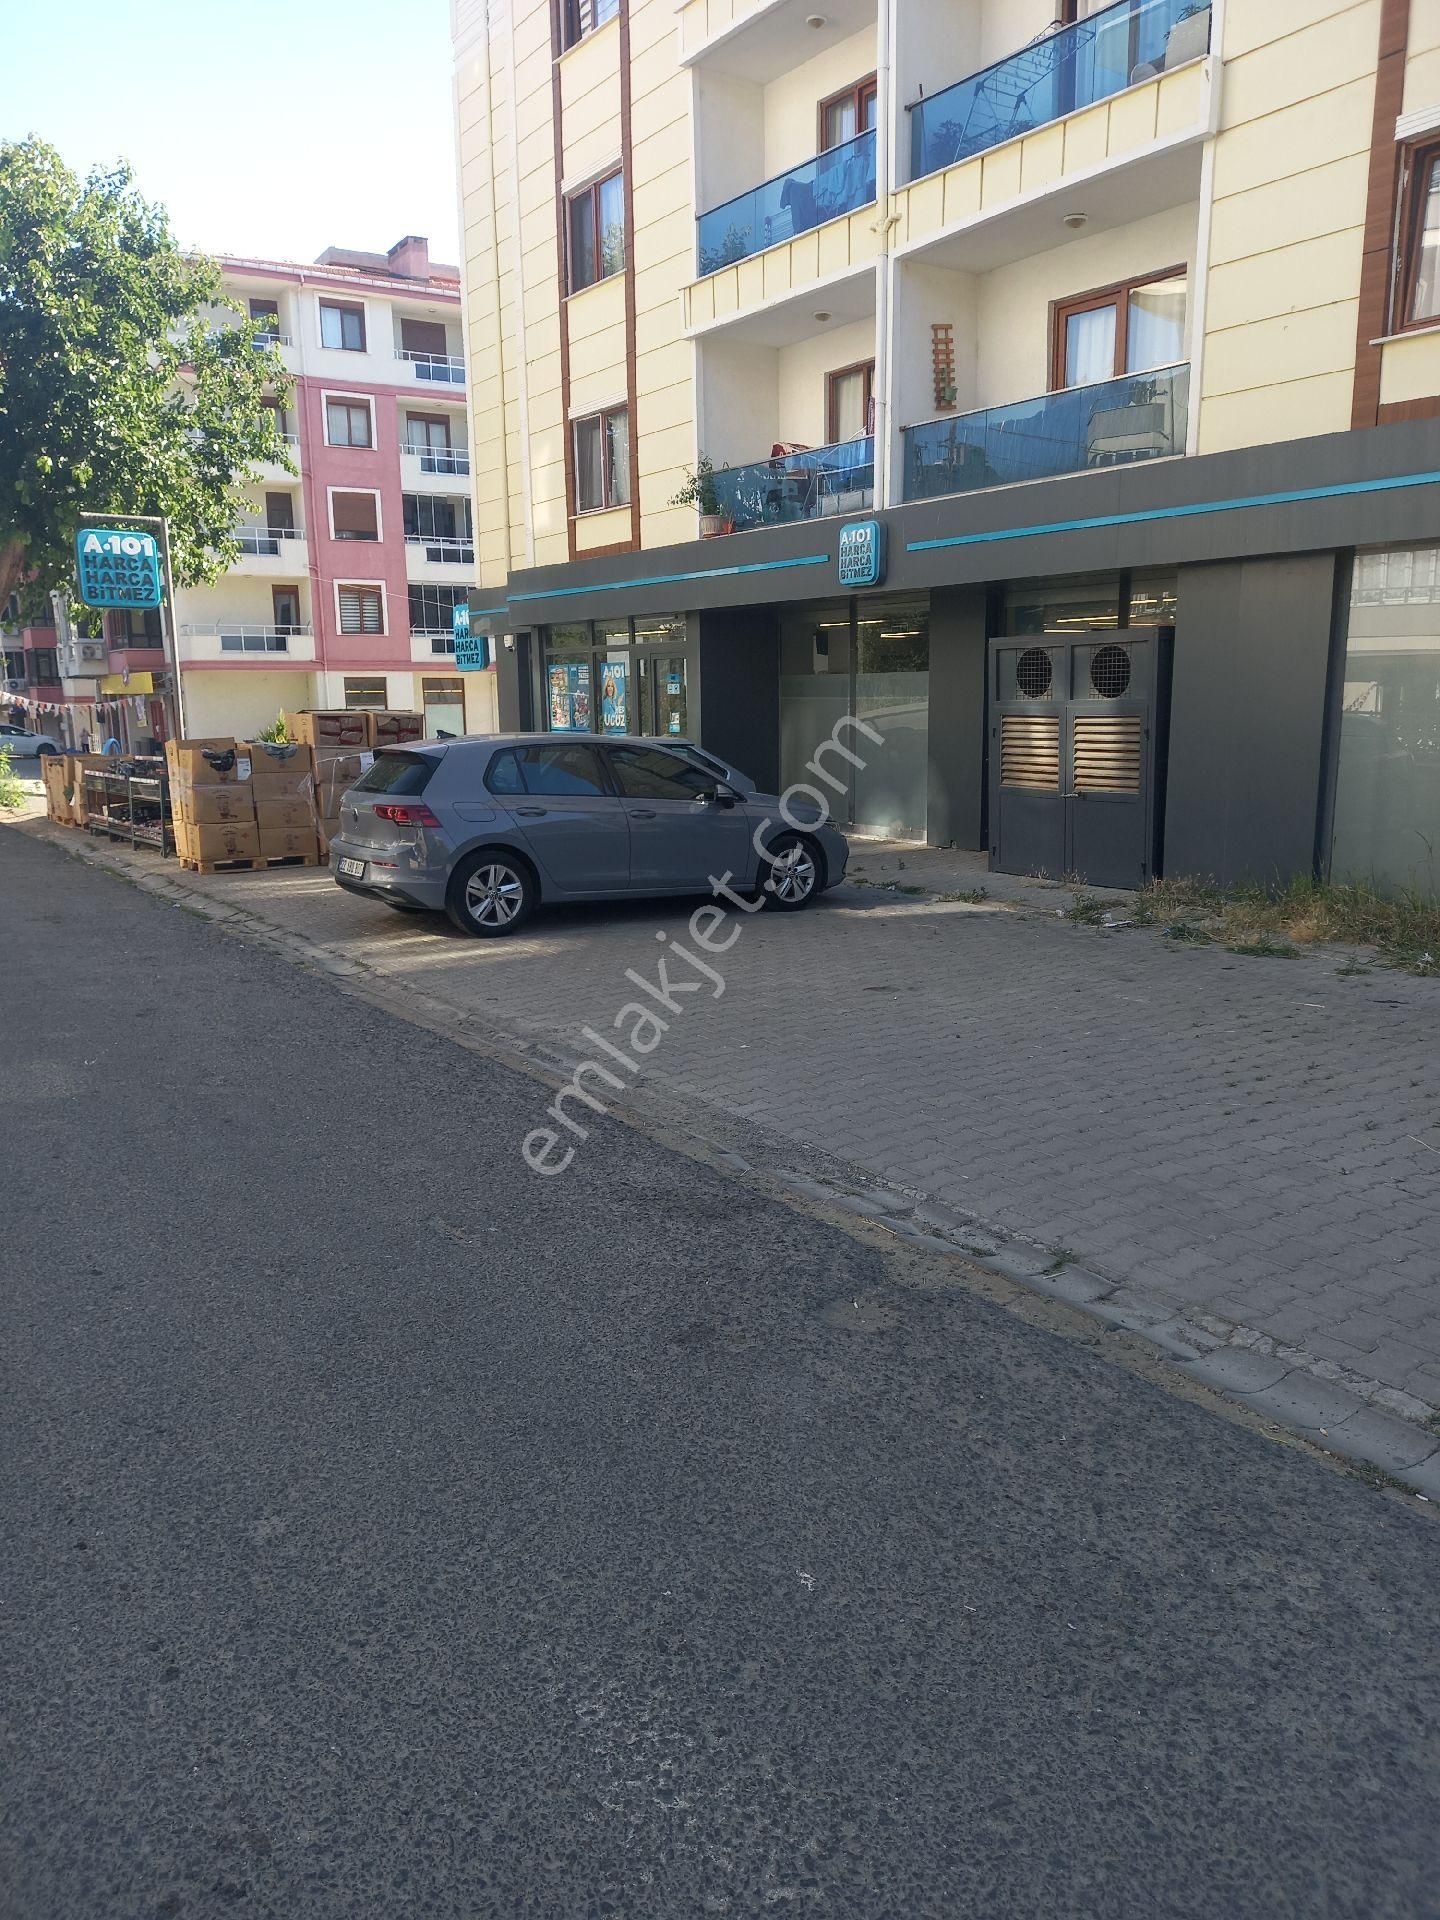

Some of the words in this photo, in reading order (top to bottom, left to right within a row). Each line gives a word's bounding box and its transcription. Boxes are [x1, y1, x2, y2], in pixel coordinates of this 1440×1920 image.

[840, 543, 872, 557] HARCA
[83, 555, 154, 573] HARCA
[840, 555, 872, 569] HARCA
[86, 570, 155, 587] HARCA
[455, 640, 479, 653] HARCA
